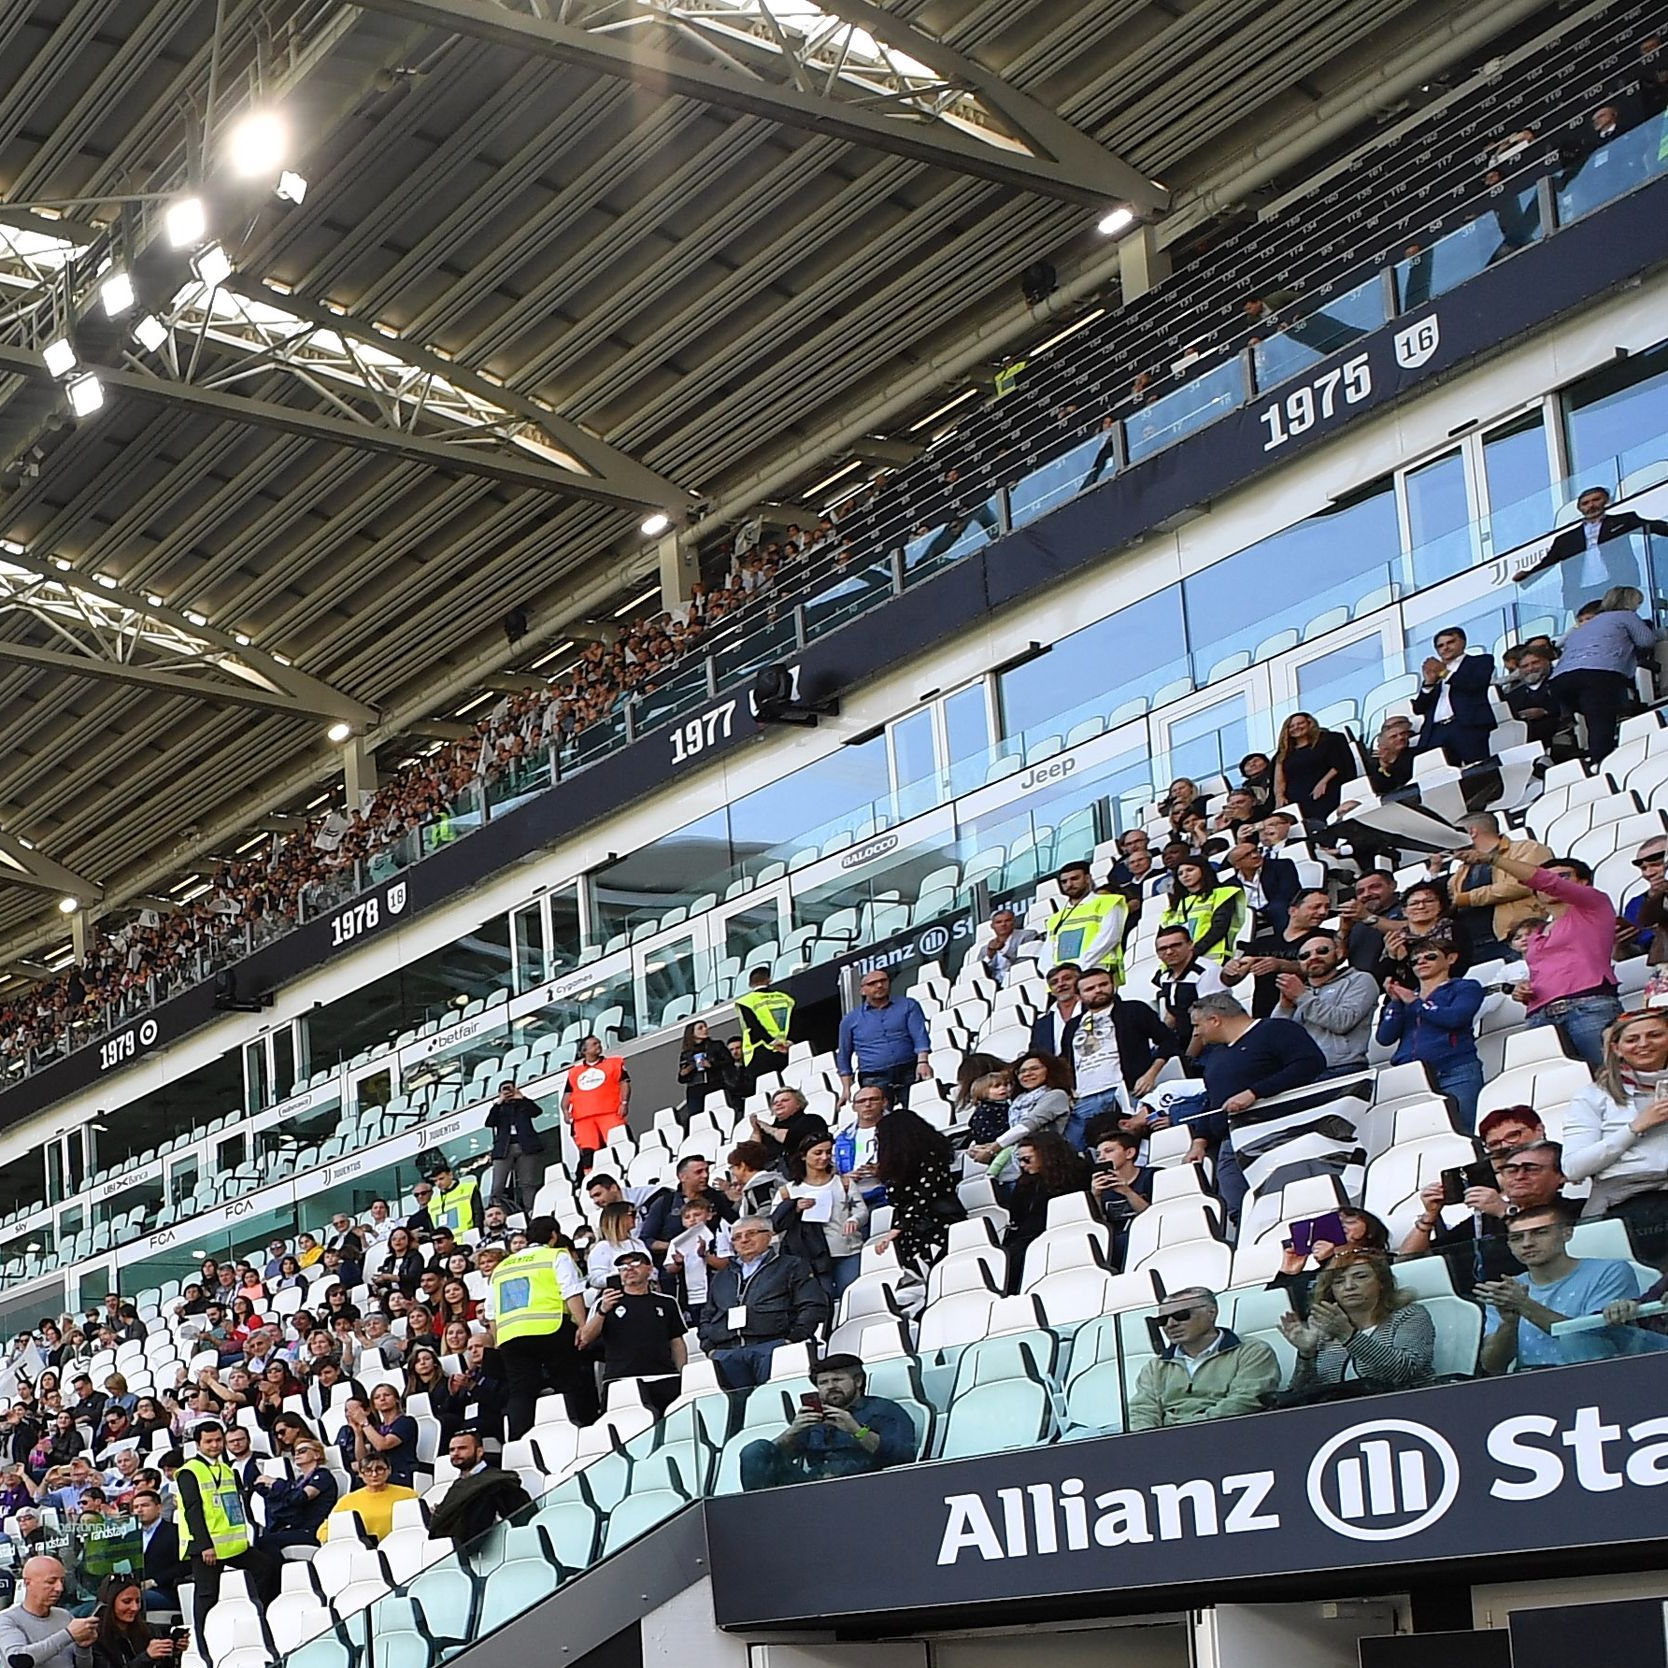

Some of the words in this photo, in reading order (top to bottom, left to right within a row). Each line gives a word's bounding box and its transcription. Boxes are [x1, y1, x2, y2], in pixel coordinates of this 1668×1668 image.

[1401, 325, 1434, 361] 16
[1260, 352, 1371, 452] 1975
[670, 700, 736, 765] 1977
[1020, 756, 1076, 791] Jeep
[843, 835, 897, 868] BALOCCO
[331, 906, 379, 947] 1978
[100, 1030, 136, 1071] 1979
[438, 1020, 480, 1048] betfair
[103, 1183, 117, 1196] UBI
[128, 1170, 149, 1187] Banca
[333, 1161, 361, 1181] JUVENTUS
[225, 1200, 254, 1220] FCA
[15, 1222, 28, 1234] sky
[150, 1231, 176, 1249] FCA
[936, 1471, 1280, 1566] Allianz
